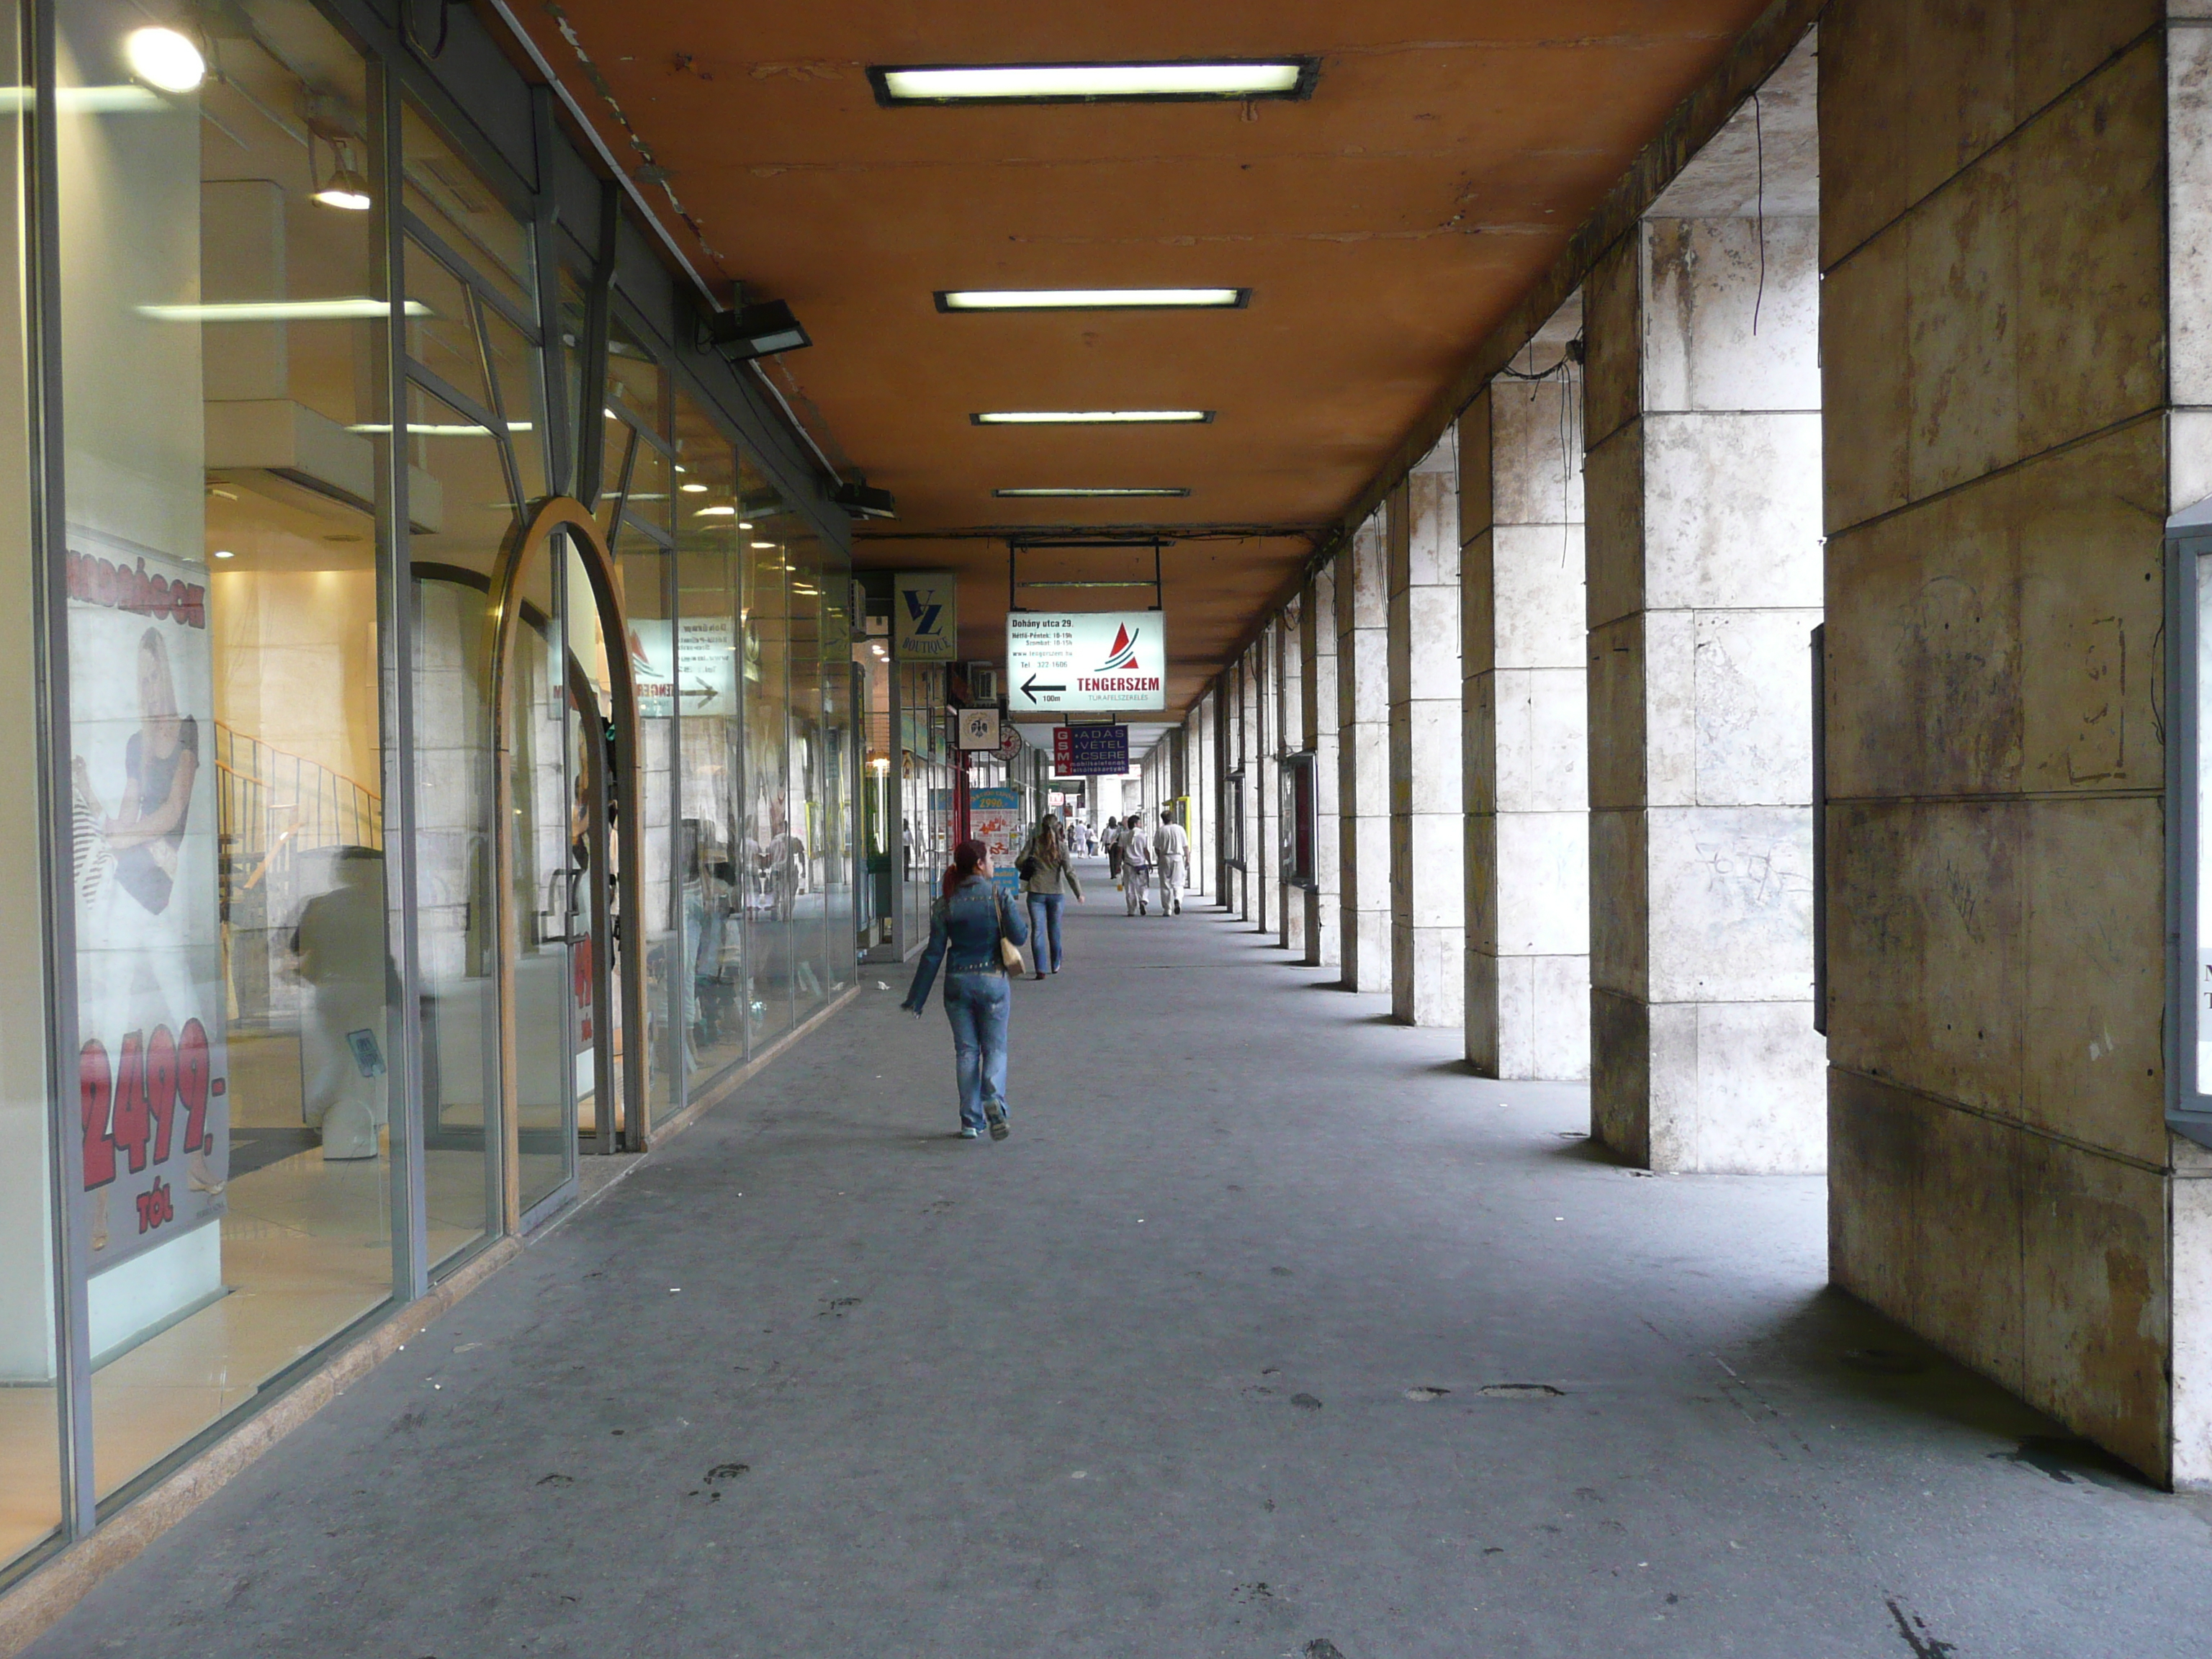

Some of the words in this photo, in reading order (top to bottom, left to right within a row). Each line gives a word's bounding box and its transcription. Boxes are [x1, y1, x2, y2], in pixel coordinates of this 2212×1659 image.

[1012, 619, 1040, 629] Dohány
[902, 637, 952, 655] BOUTIQUE
[1077, 678, 1159, 691] TENGERSZEM
